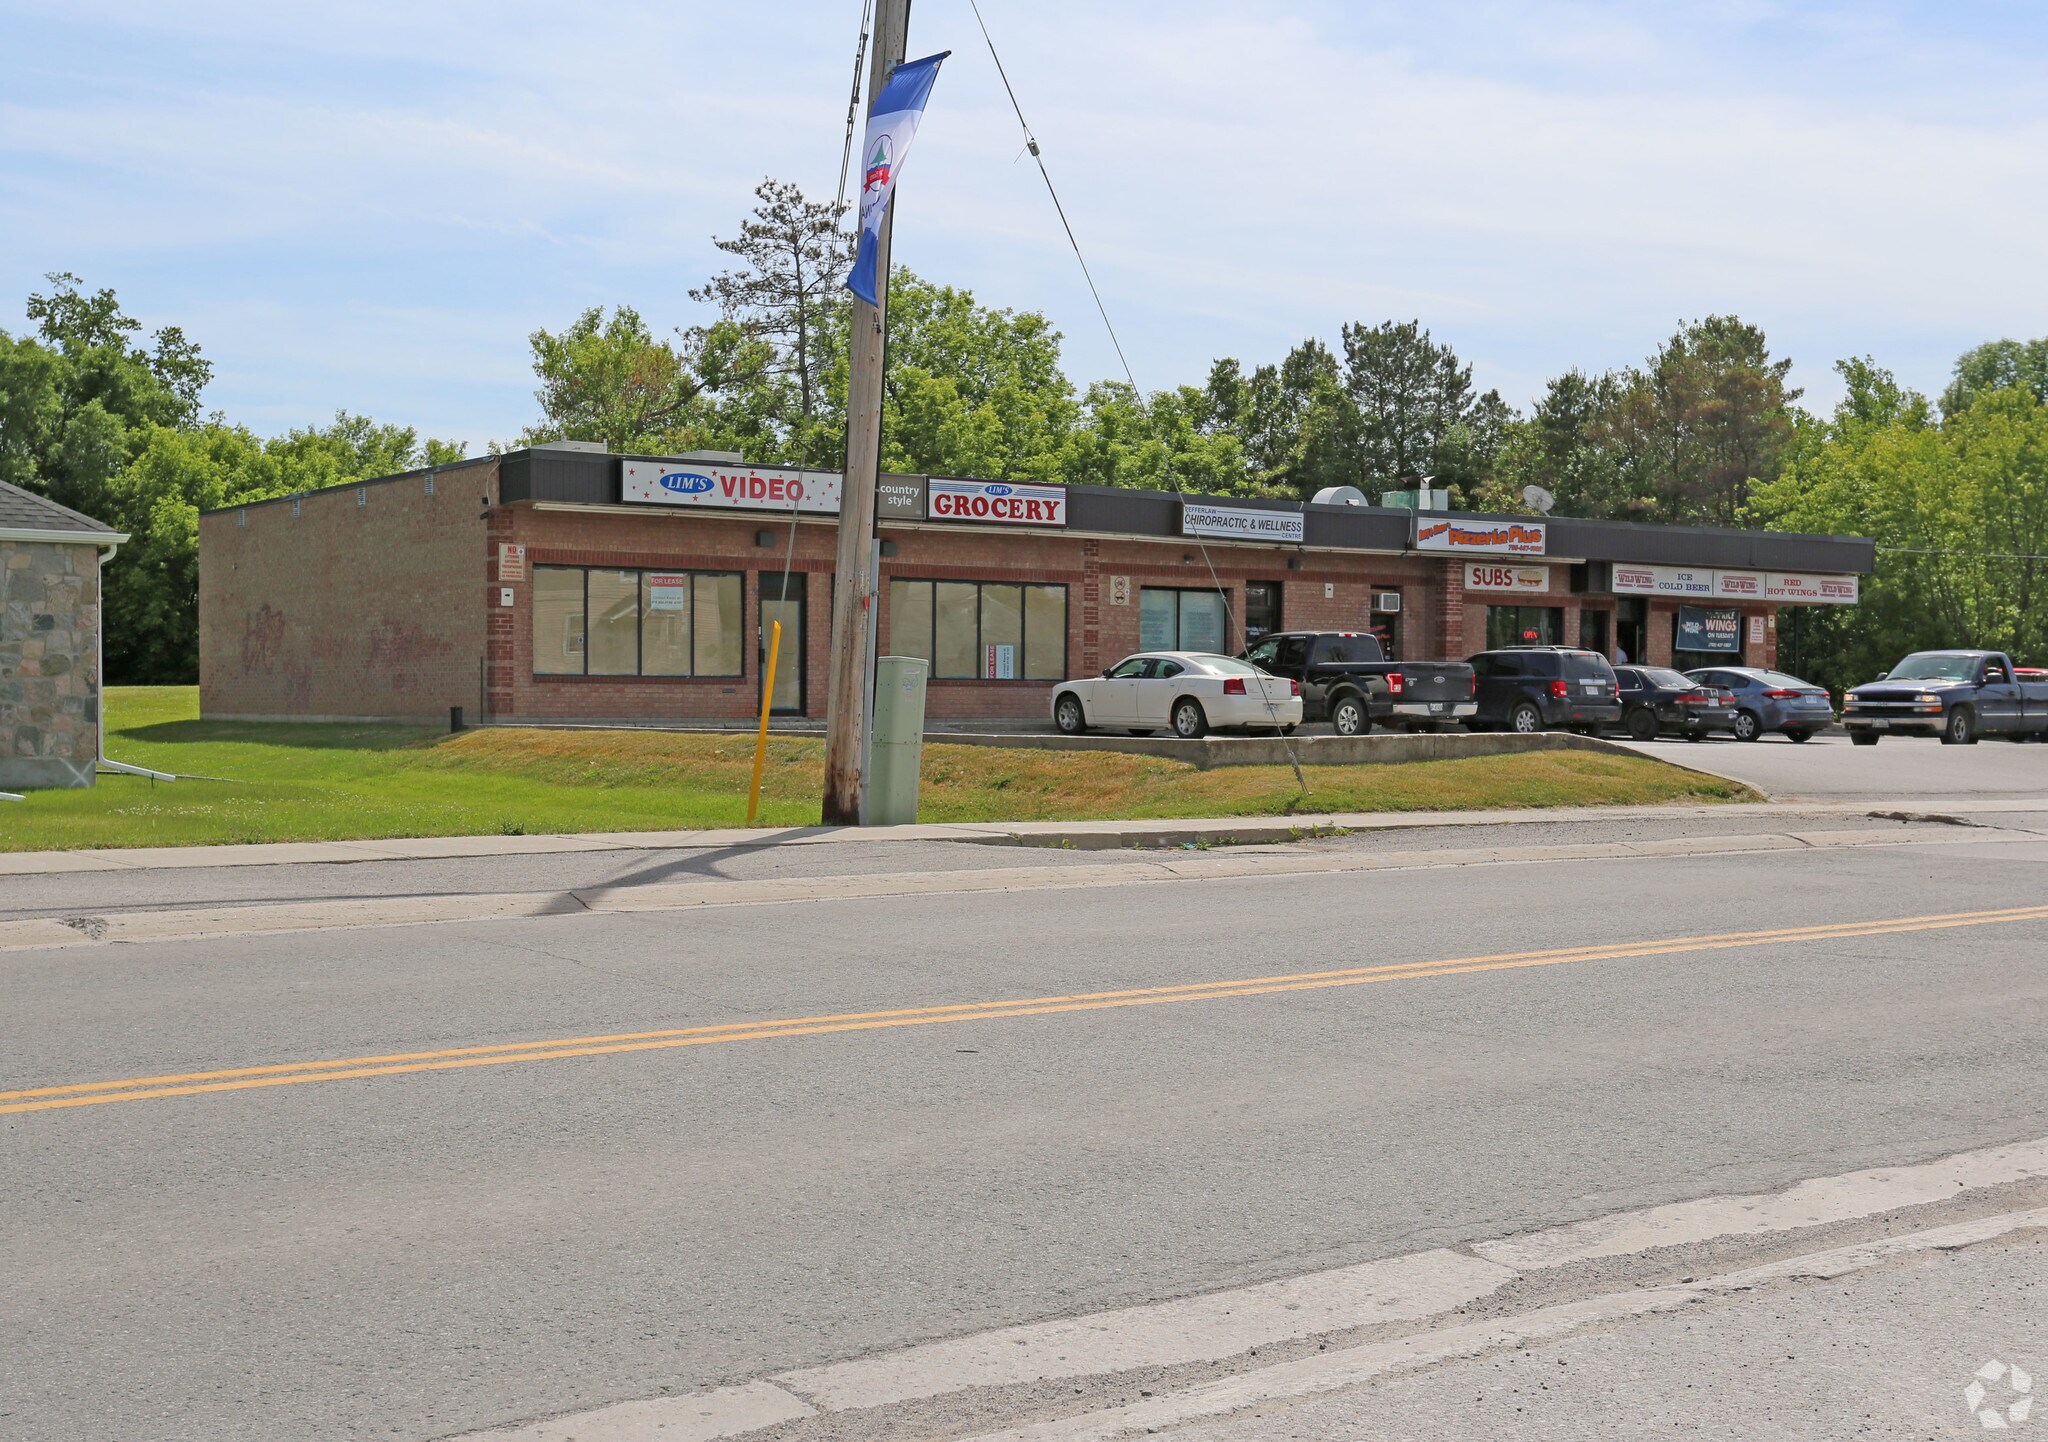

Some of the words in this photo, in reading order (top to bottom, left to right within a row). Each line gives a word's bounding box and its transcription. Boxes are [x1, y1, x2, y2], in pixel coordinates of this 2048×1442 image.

[667, 476, 708, 490] LIM'S
[720, 475, 804, 501] VIDEO
[880, 484, 920, 498] country
[988, 486, 1009, 495] LIM'S
[887, 495, 912, 507] style
[934, 494, 1061, 521] GROCERY
[1185, 506, 1217, 514] PEFFERLAW
[1184, 514, 1248, 529] CHIROPRACTIC
[1250, 519, 1256, 529] &
[1258, 519, 1302, 532] WELLNESS
[1448, 527, 1509, 545] Pizzeria
[1508, 525, 1542, 543] Plus
[507, 545, 517, 554] NO
[1472, 567, 1513, 586] SUBS
[1677, 573, 1693, 581] ICE
[1783, 578, 1802, 587] RED
[1658, 582, 1683, 591] COLD
[1685, 583, 1710, 592] BEER
[1767, 587, 1785, 596] HOT
[1788, 588, 1818, 597] WINGS
[1705, 619, 1737, 632] WINGS
